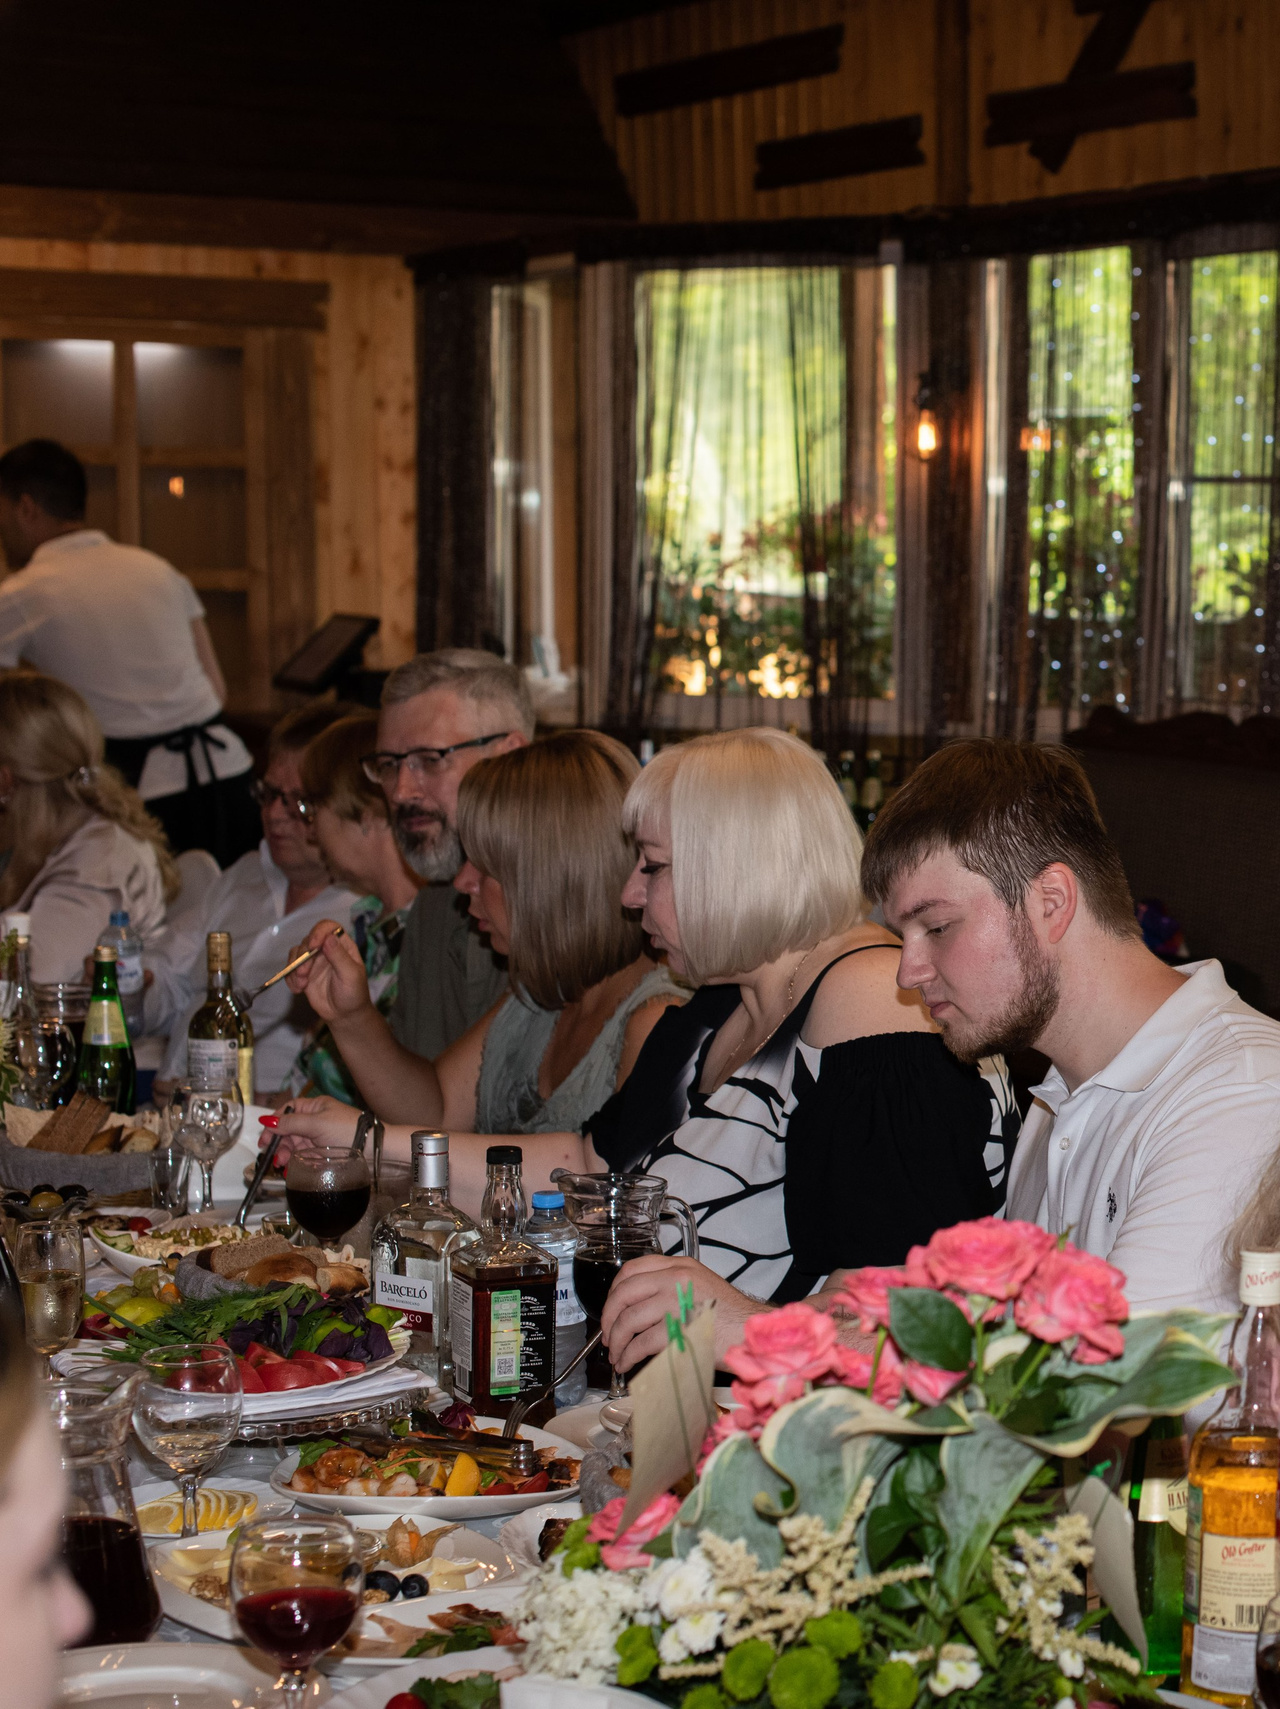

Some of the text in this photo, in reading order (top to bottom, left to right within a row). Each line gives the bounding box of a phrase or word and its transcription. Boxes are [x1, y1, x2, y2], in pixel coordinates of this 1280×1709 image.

[380, 1280, 428, 1299] BARCELÓ
[1221, 1541, 1267, 1561] Old Crofter
